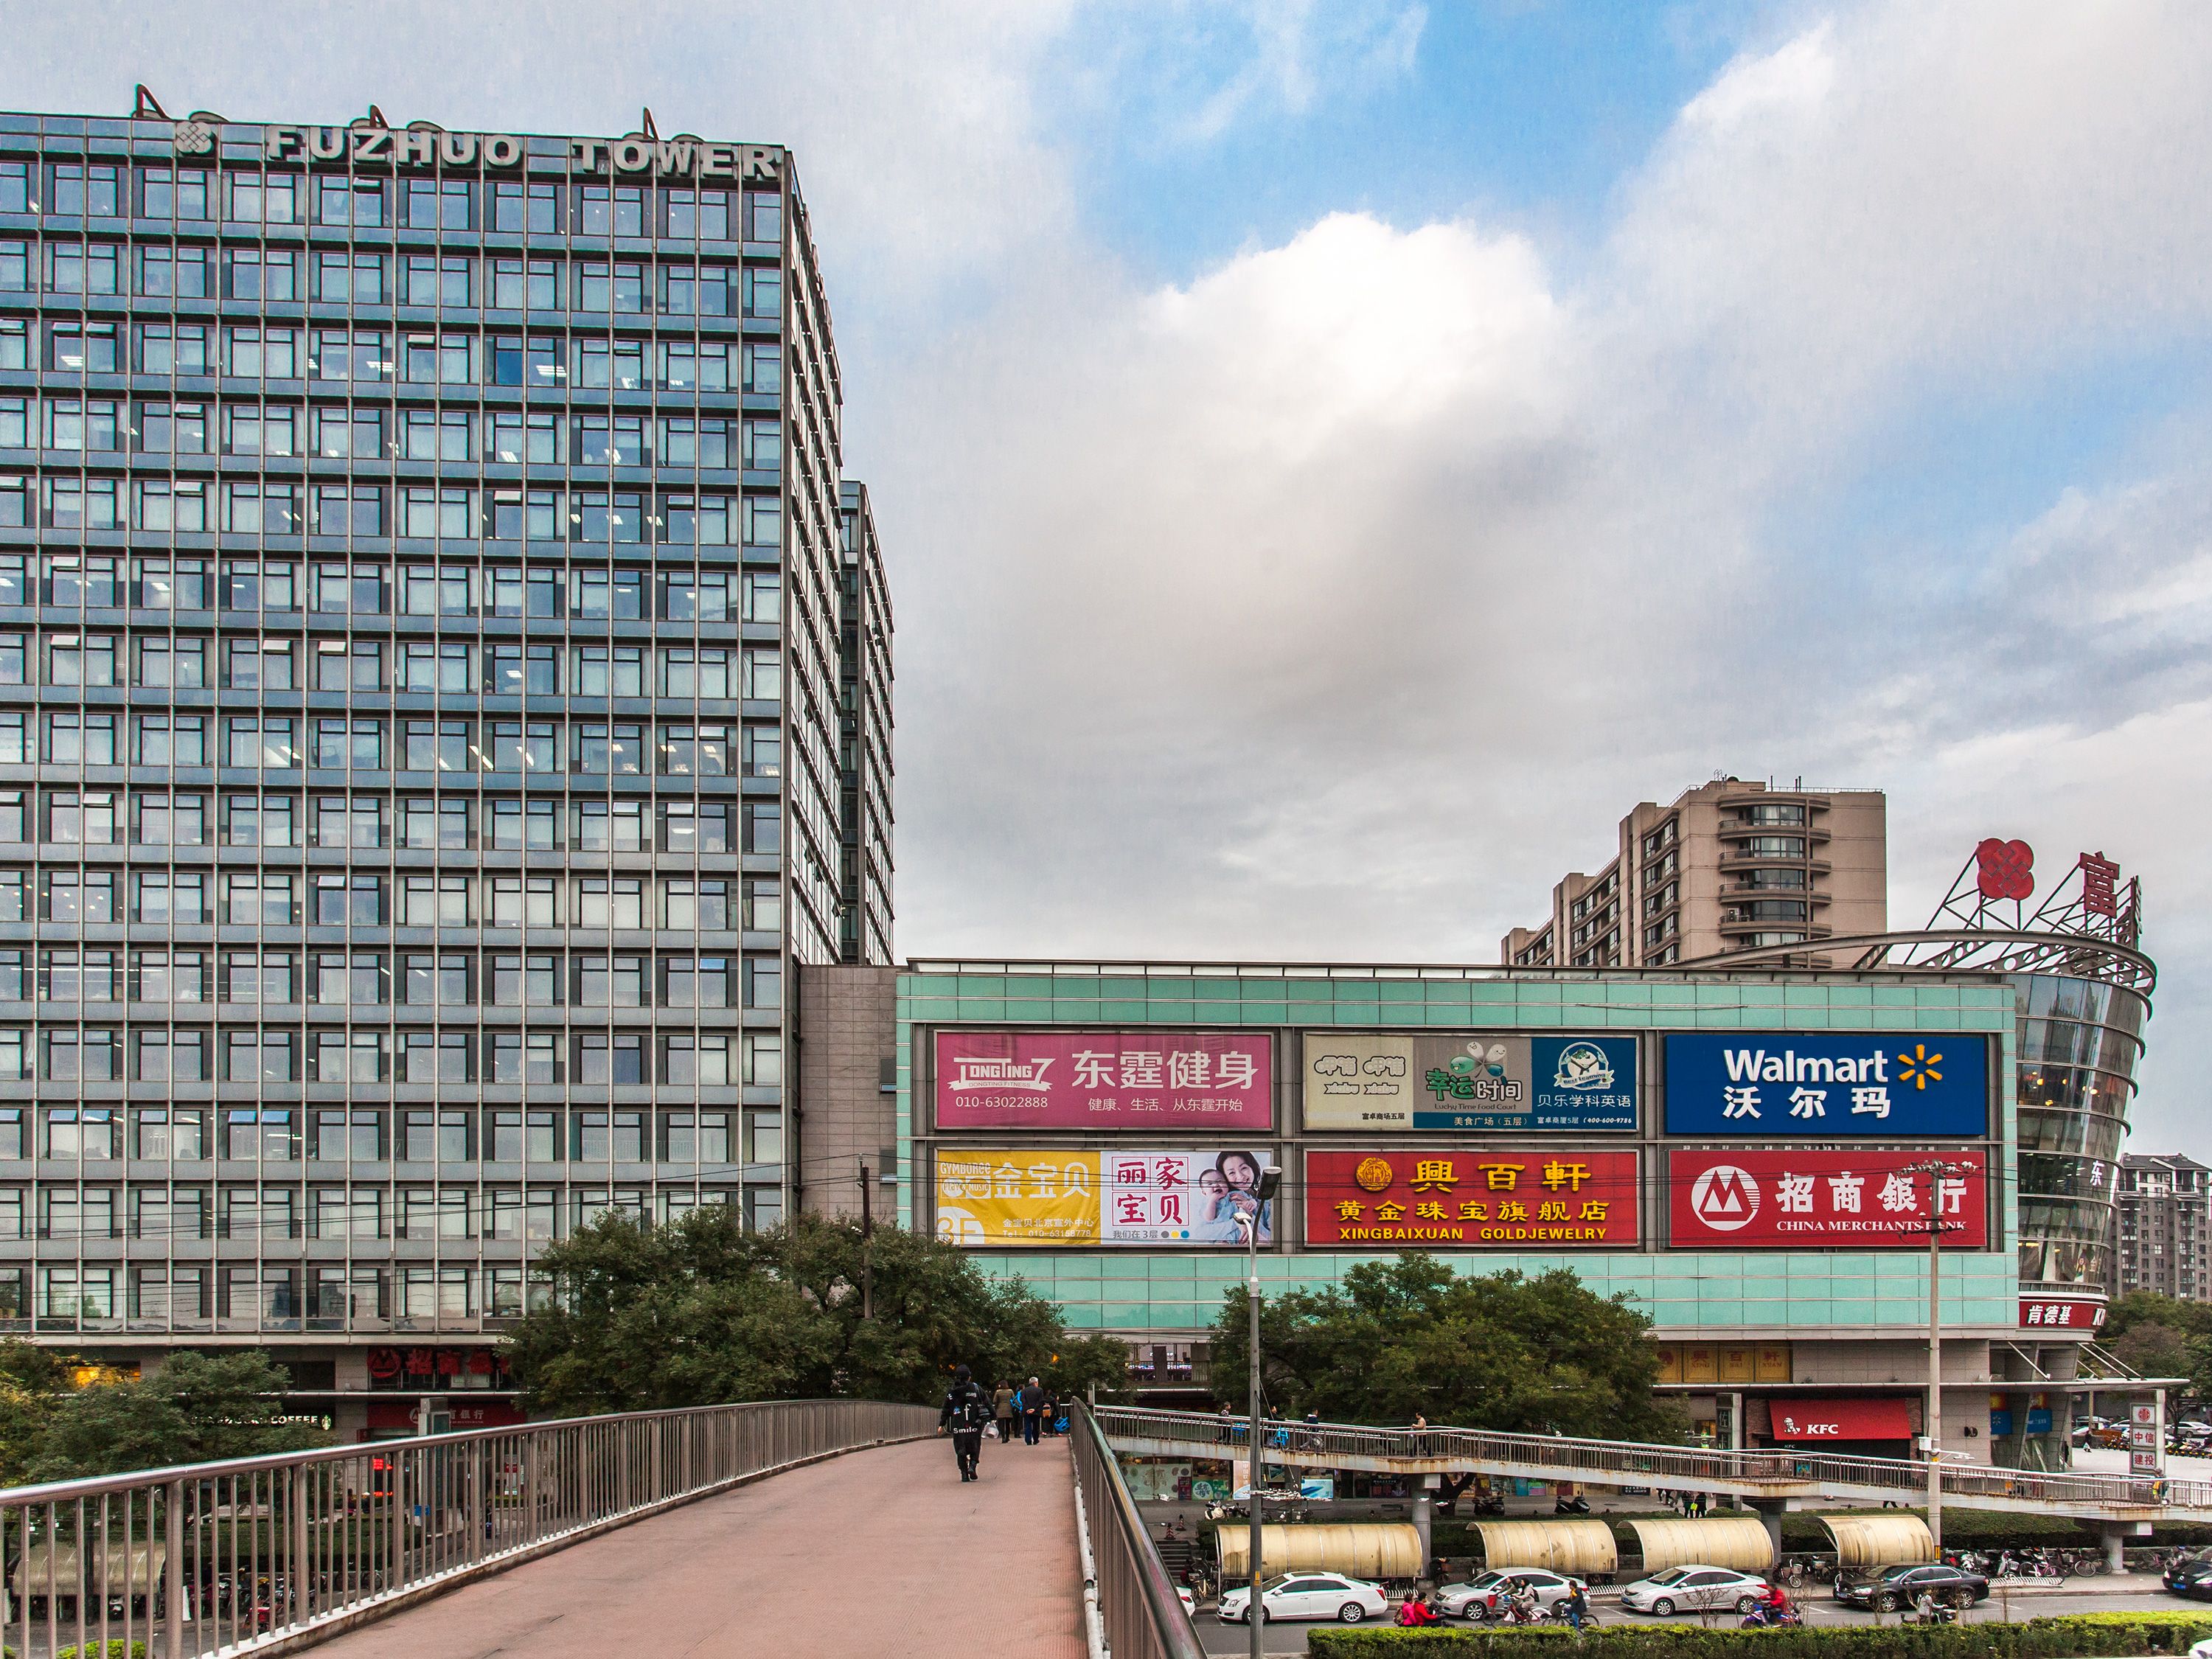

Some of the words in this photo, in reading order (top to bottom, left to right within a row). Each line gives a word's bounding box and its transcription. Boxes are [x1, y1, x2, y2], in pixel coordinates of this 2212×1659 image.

[268, 125, 521, 167] FUZHUO
[571, 138, 779, 181] TOWER
[1071, 1050, 1259, 1090] 东霆健身
[1724, 1049, 1888, 1083] Walmart
[1425, 1068, 1523, 1102] 幸运时间
[956, 1096, 1048, 1108] 010-63022888
[1088, 1097, 1243, 1112] 健康、生活、从东霆开始
[1435, 1103, 1457, 1111] Lucky
[1537, 1094, 1632, 1107] 贝乐学科英语
[1722, 1086, 1891, 1119] 沃尔玛
[992, 1161, 1091, 1198] 金宝贝
[1117, 1156, 1188, 1191] 丽家
[1410, 1159, 1592, 1193] 興百軒
[1117, 1193, 1183, 1225] 宝贝
[1333, 1200, 1610, 1222] 黄金珠宝旗舰店
[1002, 1217, 1094, 1228] 金宝贝北京宣外中心
[1776, 1220, 1825, 1231] CHINA
[1828, 1220, 1924, 1231] MERCHANTS
[1339, 1227, 1464, 1240] XINGBAIXUAN
[1480, 1227, 1607, 1240] GOLDJEWELRY
[2028, 1304, 2073, 1324] 肯德基
[1806, 1425, 1839, 1435] KFC
[2135, 1433, 2154, 1444] 中信
[2135, 1455, 2154, 1466] 建投
